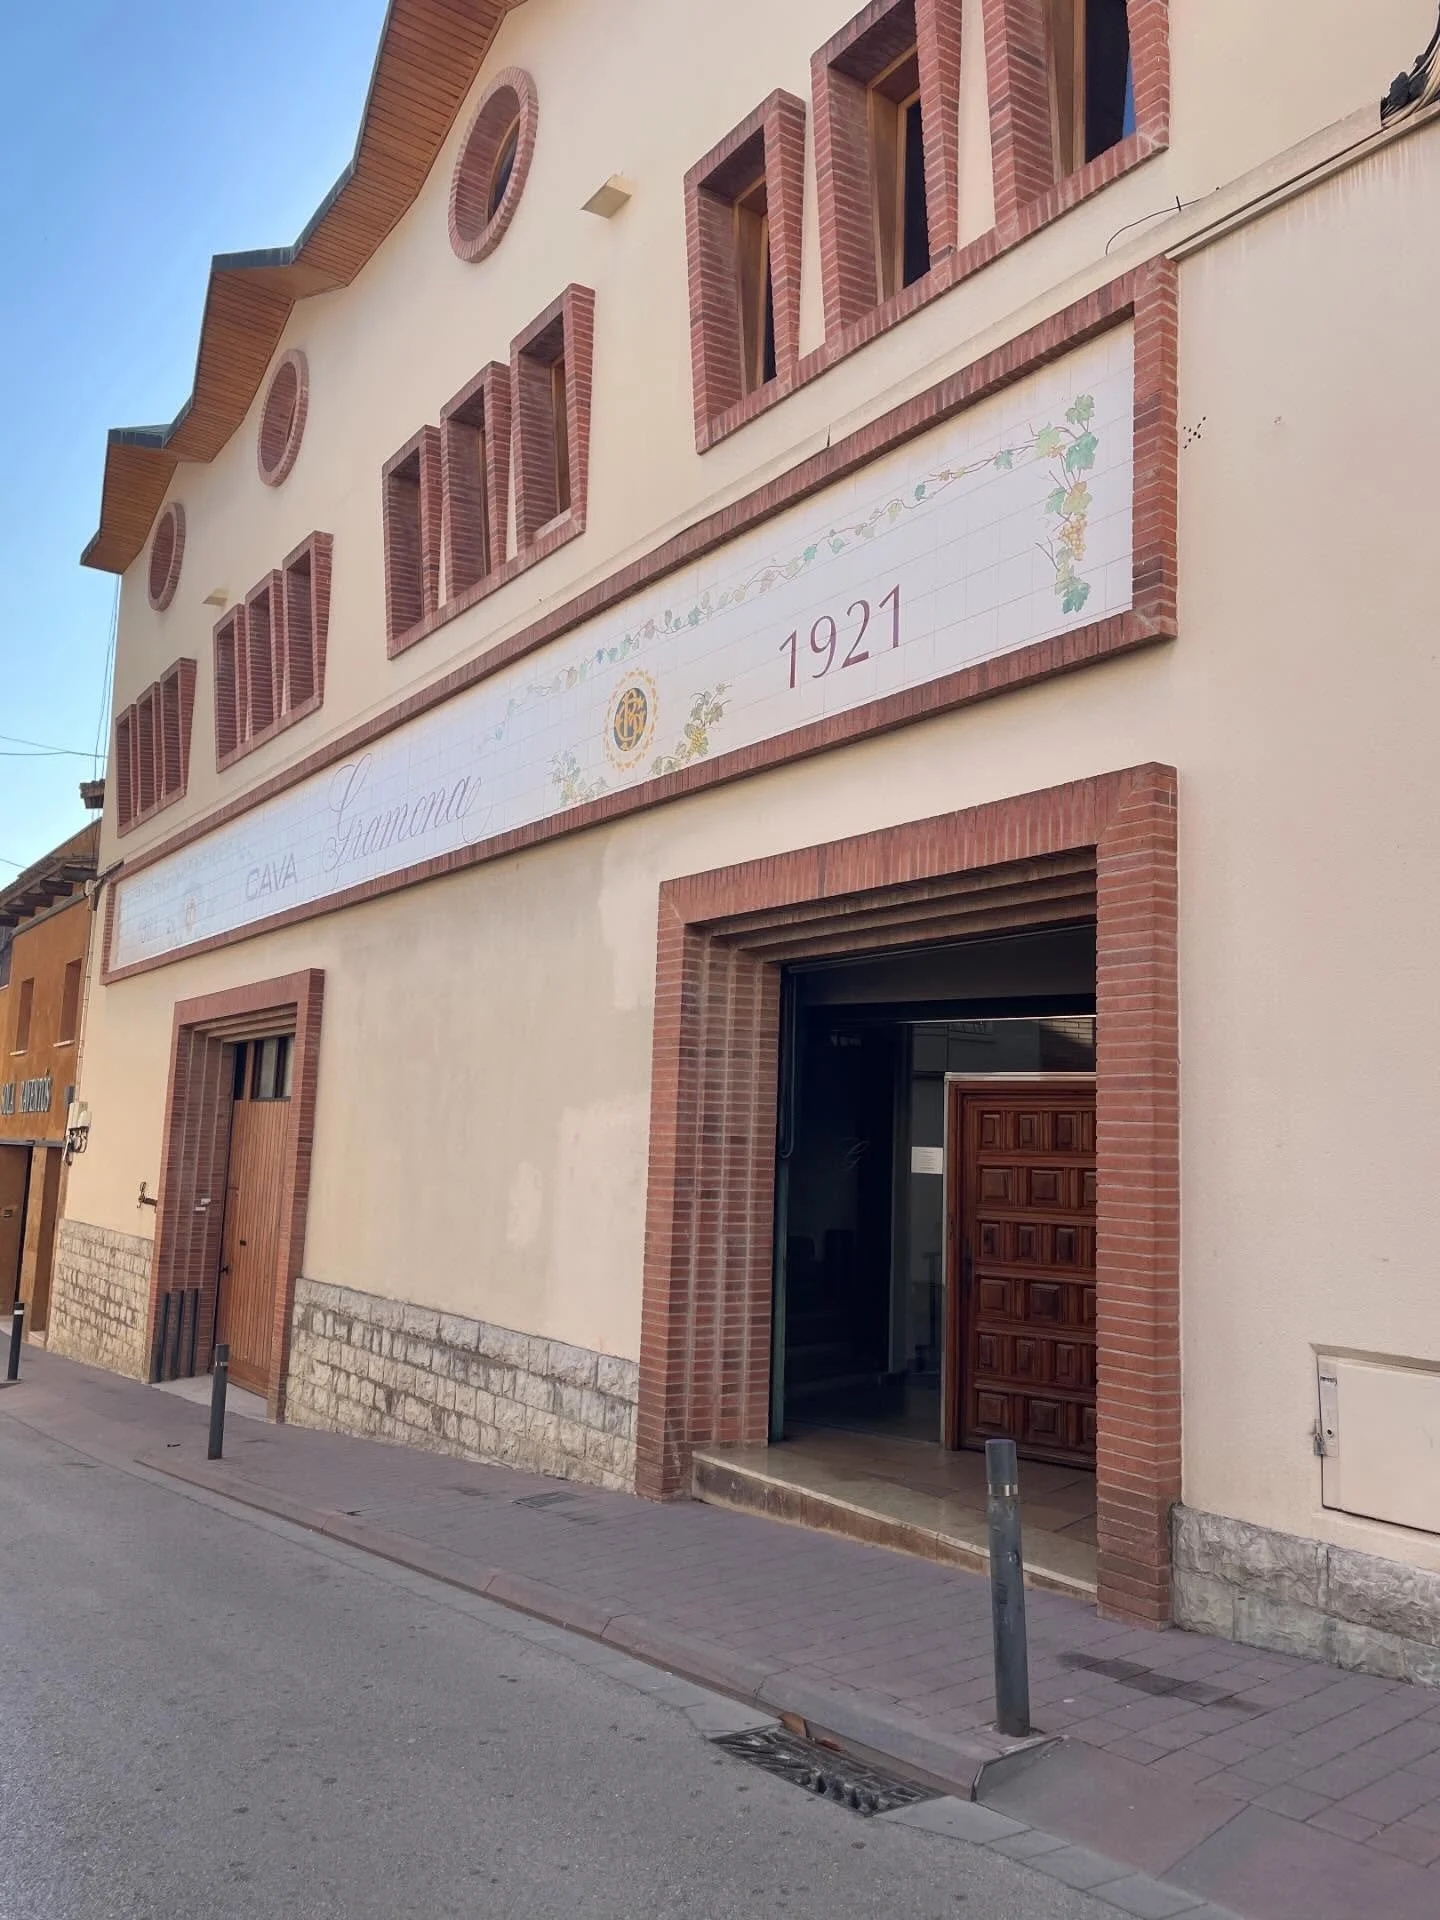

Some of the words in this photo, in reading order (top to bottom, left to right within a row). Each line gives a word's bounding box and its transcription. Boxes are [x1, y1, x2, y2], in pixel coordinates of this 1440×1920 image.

[779, 583, 901, 689] 1921
[246, 852, 298, 902] CAVA
[322, 752, 493, 888] Gramona
